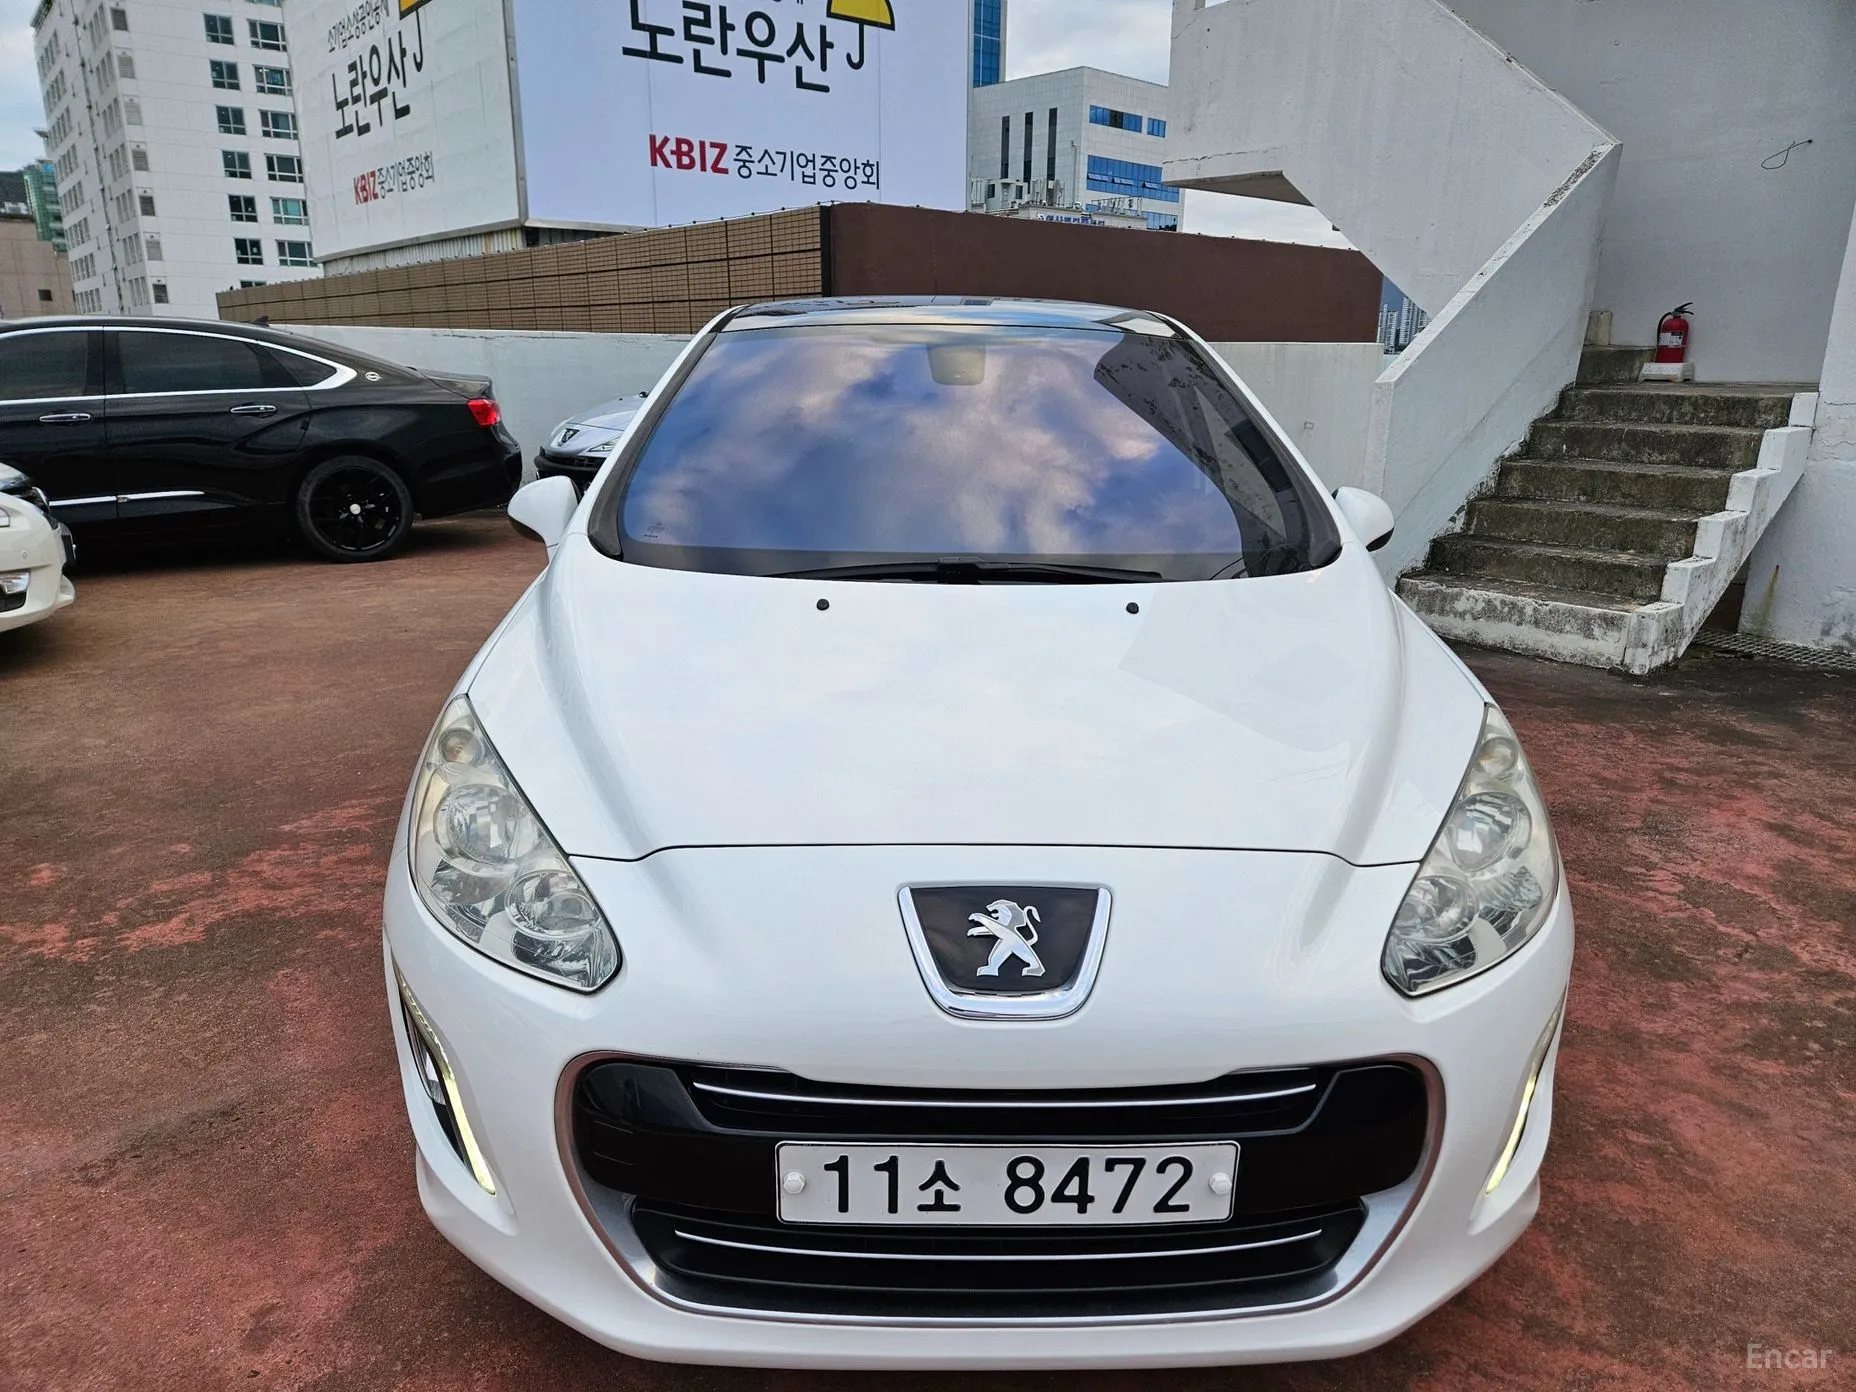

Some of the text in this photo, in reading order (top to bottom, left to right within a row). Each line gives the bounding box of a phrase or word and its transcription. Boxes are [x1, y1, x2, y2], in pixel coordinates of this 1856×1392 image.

[622, 0, 835, 93] 노란우산
[332, 30, 411, 139] 노란우산
[377, 151, 435, 199] 중소기업중앙회
[649, 134, 880, 190] K-BIZ 중소기업중앙회
[823, 1154, 1195, 1214] 11소 8472
